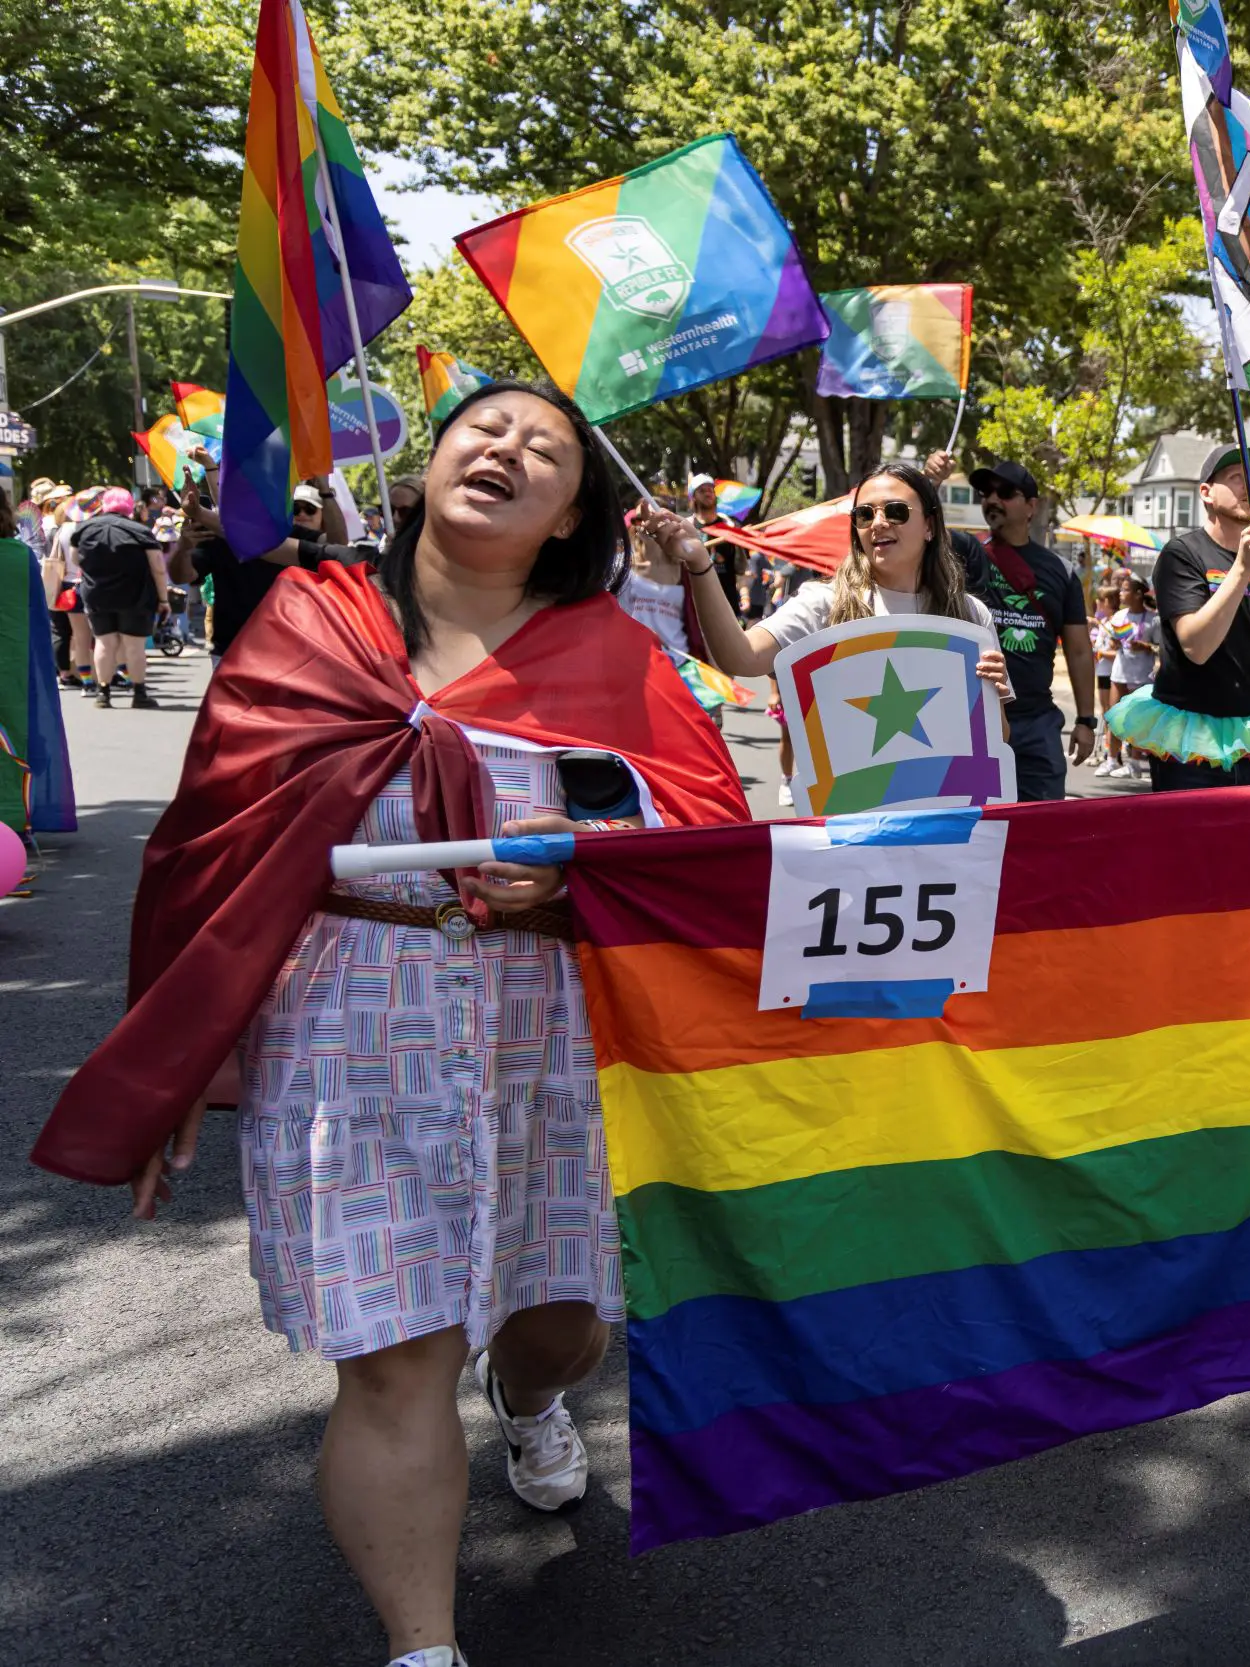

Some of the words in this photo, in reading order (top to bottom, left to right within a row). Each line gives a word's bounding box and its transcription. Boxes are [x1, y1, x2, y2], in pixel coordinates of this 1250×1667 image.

[646, 313, 738, 354] westernhealth
[652, 335, 719, 366] ADVANTAGE
[803, 883, 957, 958] 155
